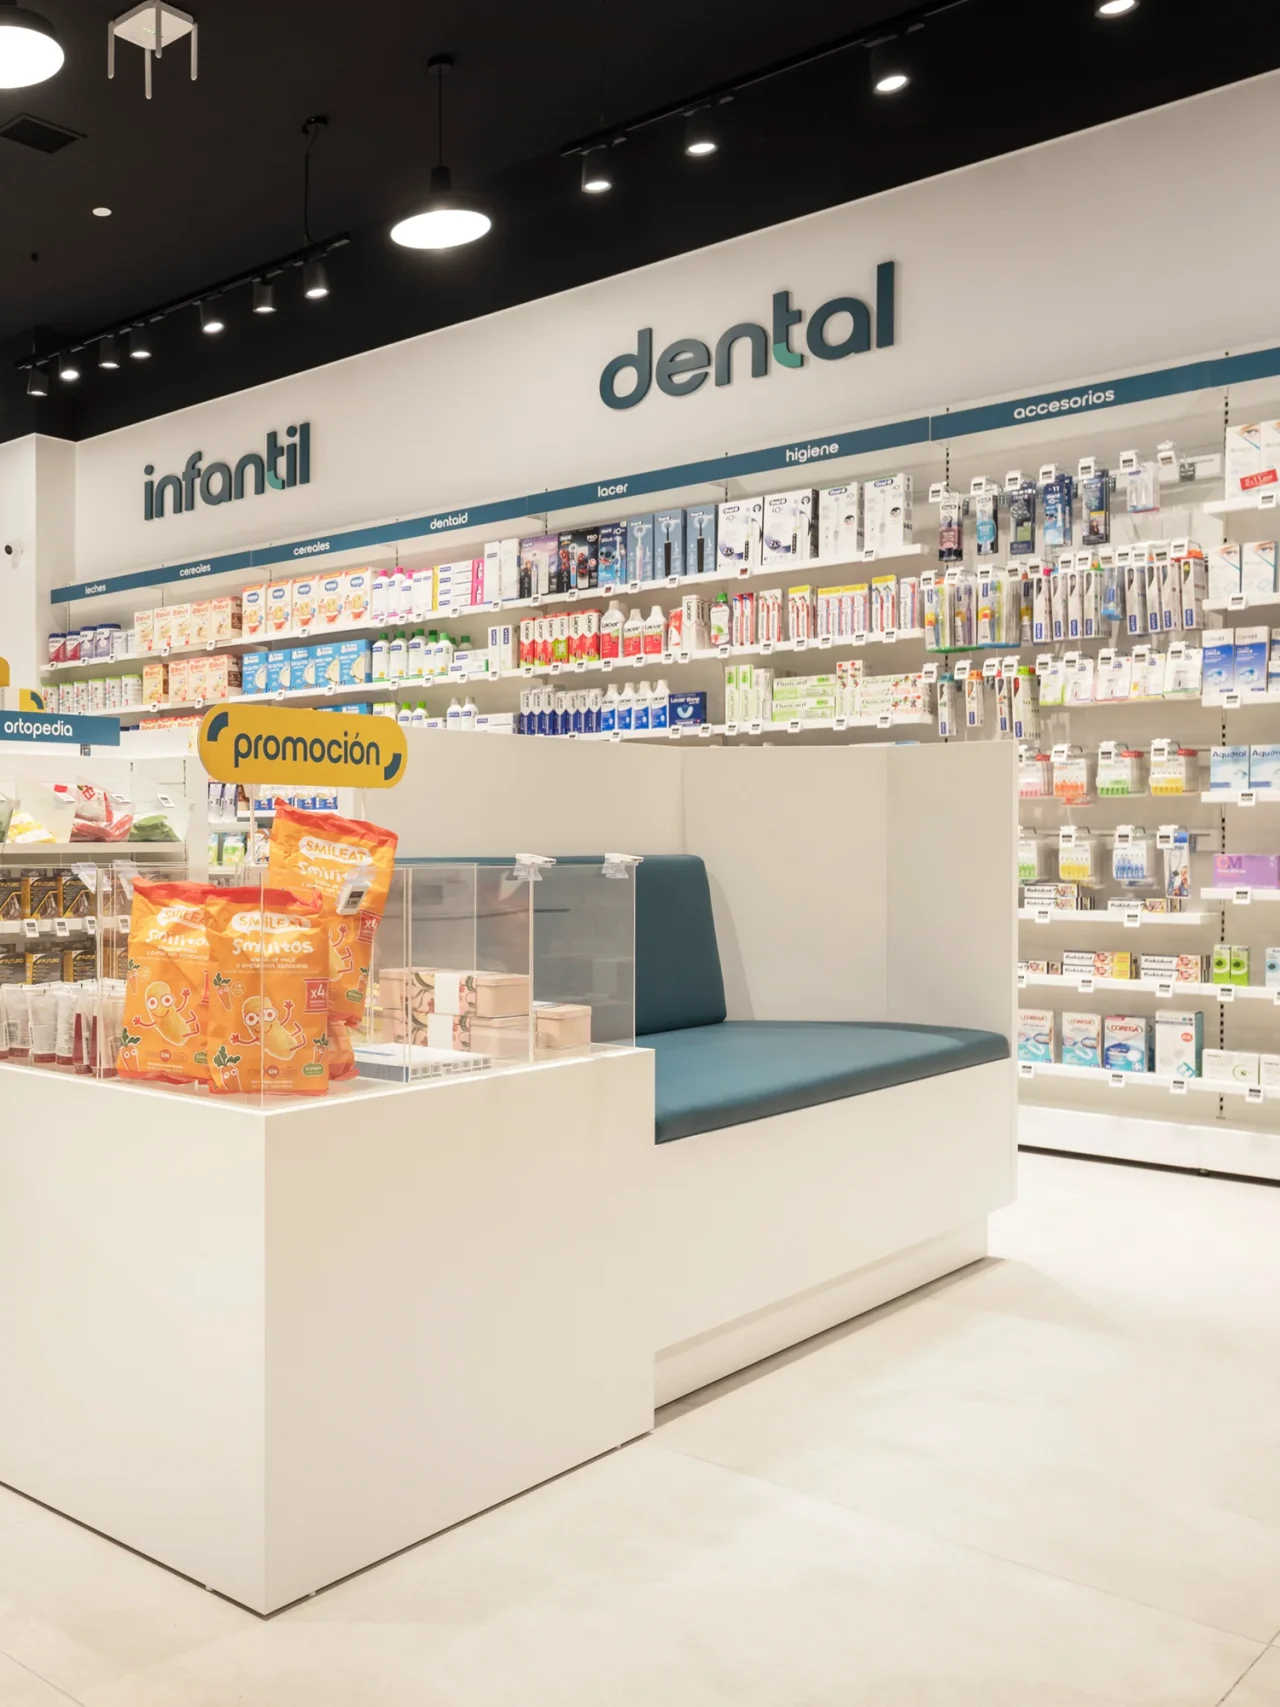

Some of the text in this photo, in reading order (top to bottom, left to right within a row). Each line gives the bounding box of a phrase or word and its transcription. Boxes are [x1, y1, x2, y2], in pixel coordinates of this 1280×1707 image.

[599, 261, 895, 410] dental
[1013, 389, 1115, 420] accesorios
[785, 440, 839, 465] higiene
[144, 422, 311, 521] infantil
[597, 483, 628, 498] lacer
[430, 512, 468, 531] dentaid
[293, 540, 330, 555] cereales
[179, 562, 212, 577] cereales
[84, 581, 107, 595] leches
[3, 717, 74, 739] ortopedia
[233, 730, 381, 769] promoción
[306, 840, 366, 862] SMILEAT
[310, 984, 325, 1000] x4
[1111, 1024, 1140, 1033] COREGA
